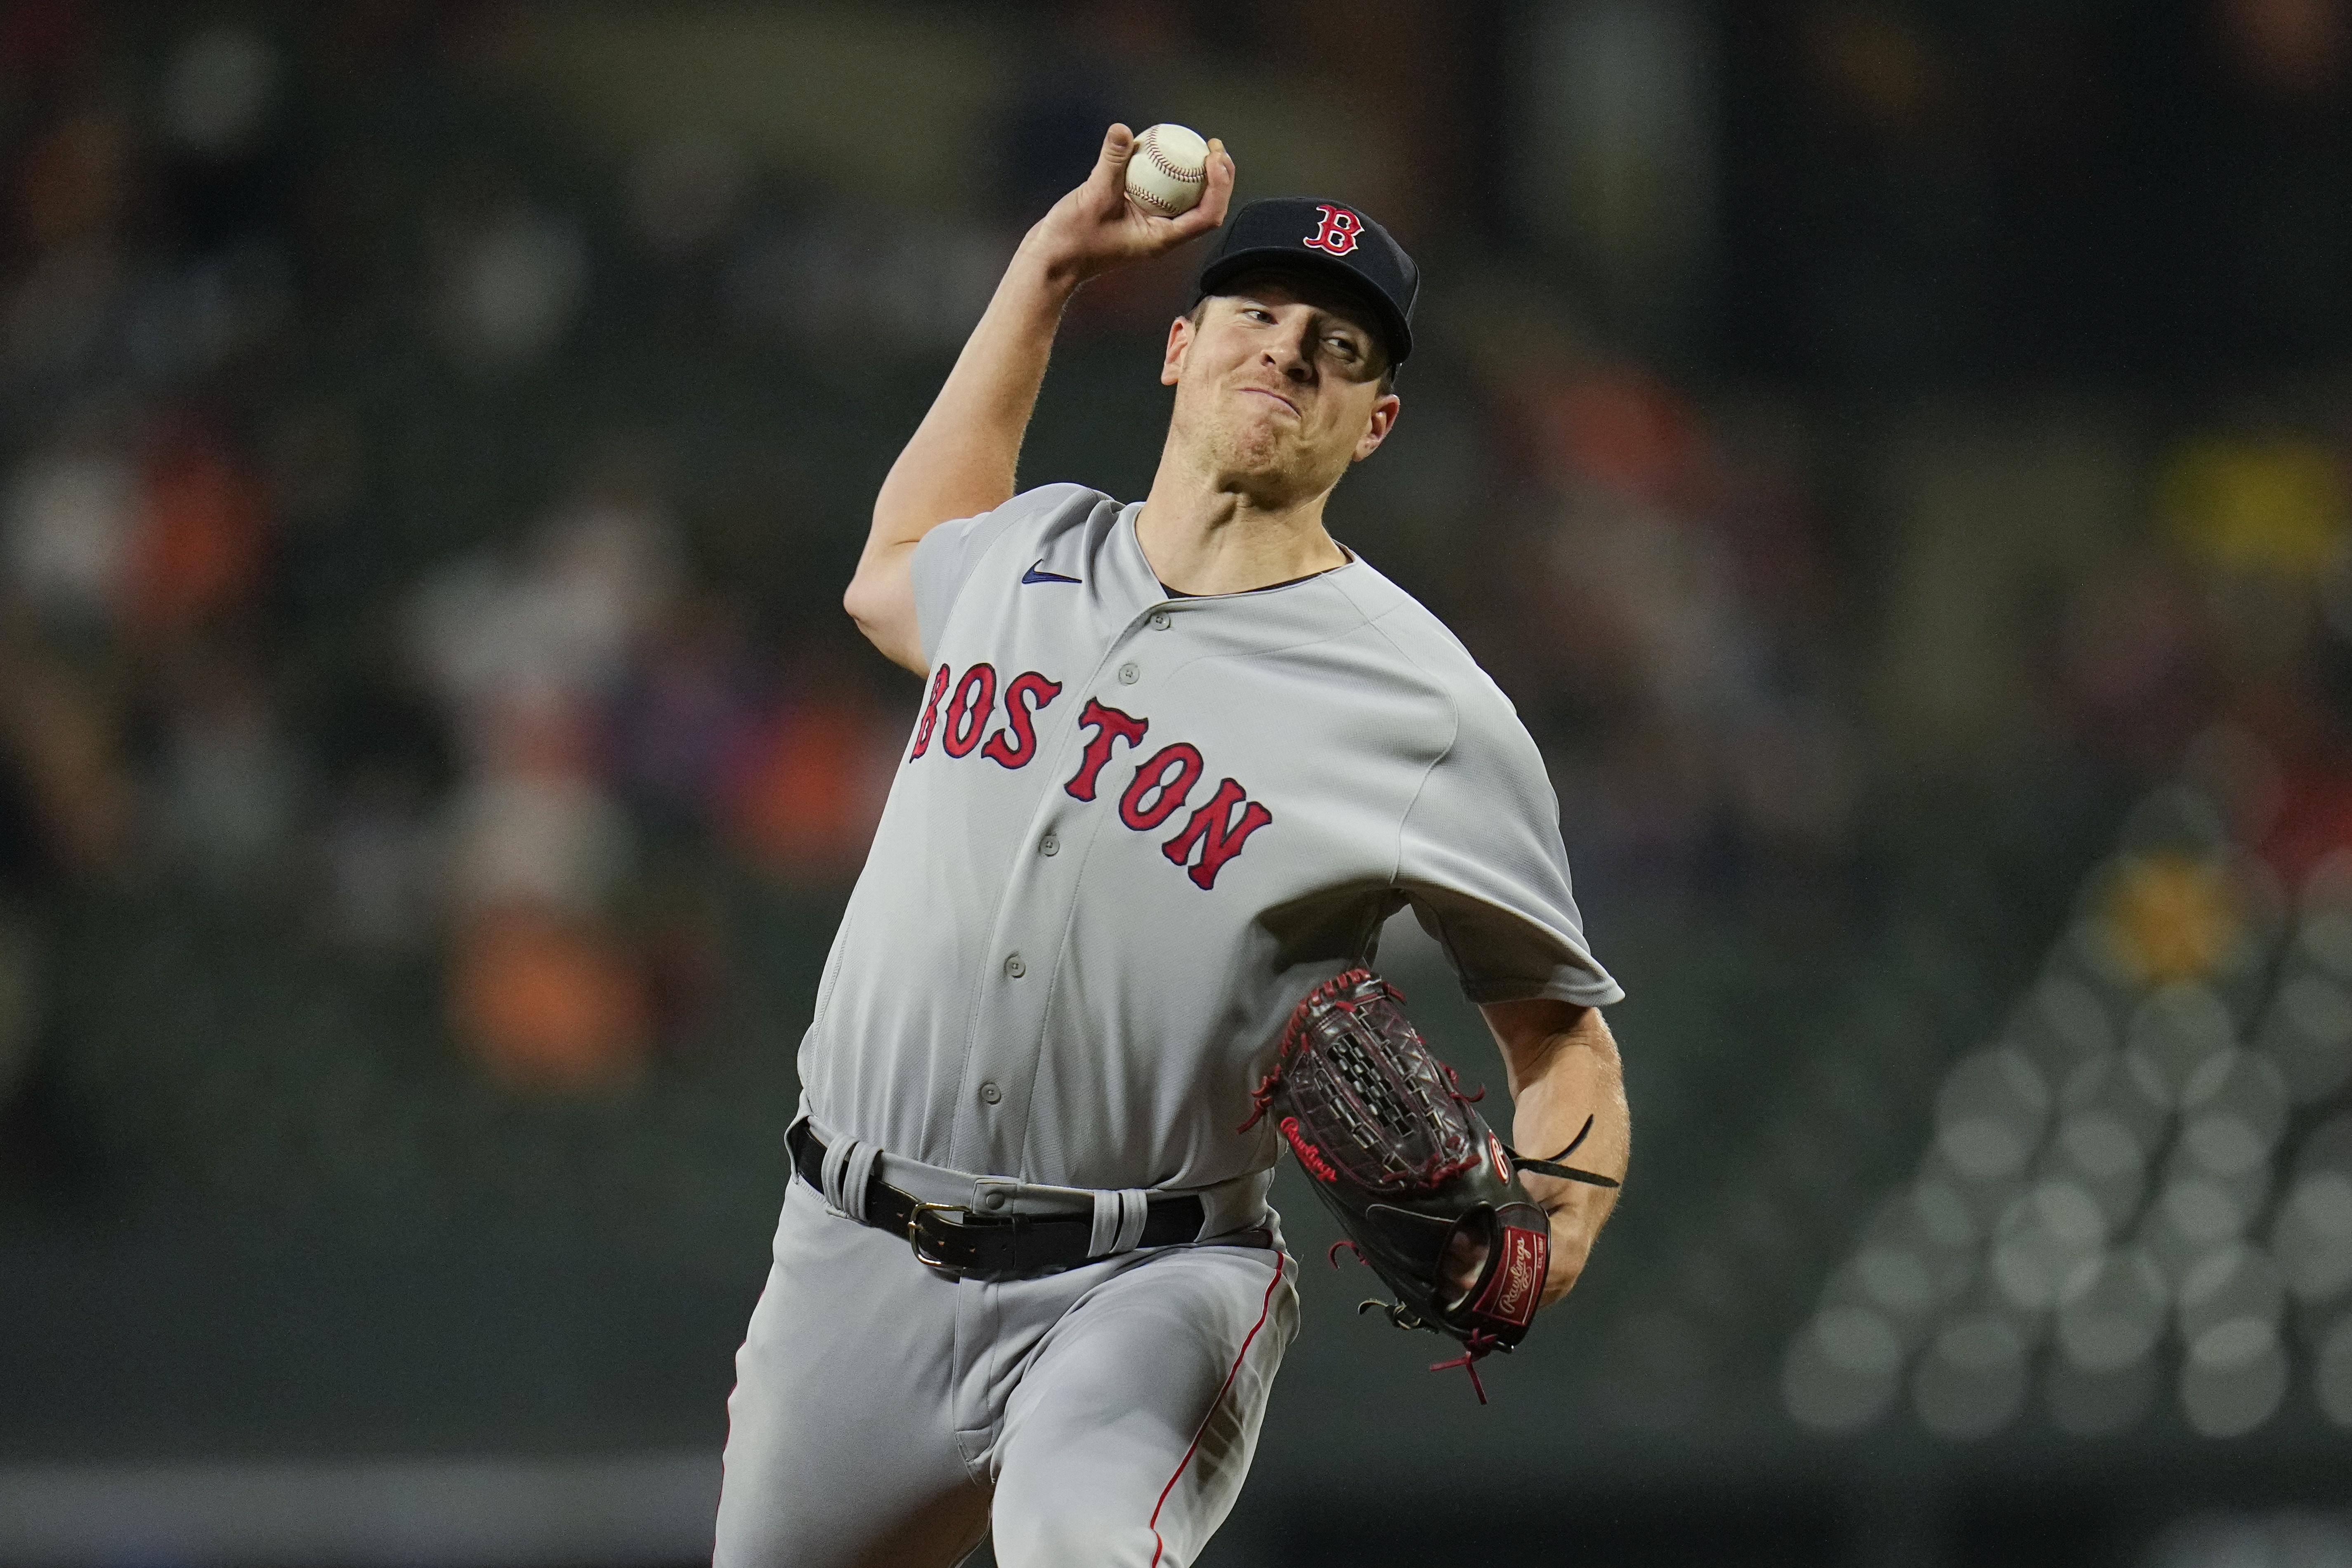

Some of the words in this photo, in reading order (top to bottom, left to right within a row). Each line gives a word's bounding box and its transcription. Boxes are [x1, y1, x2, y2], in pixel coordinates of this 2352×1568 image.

[1303, 204, 1365, 256] B
[909, 663, 1272, 890] BOSTON
[1500, 1236, 1532, 1314] Rawlings
